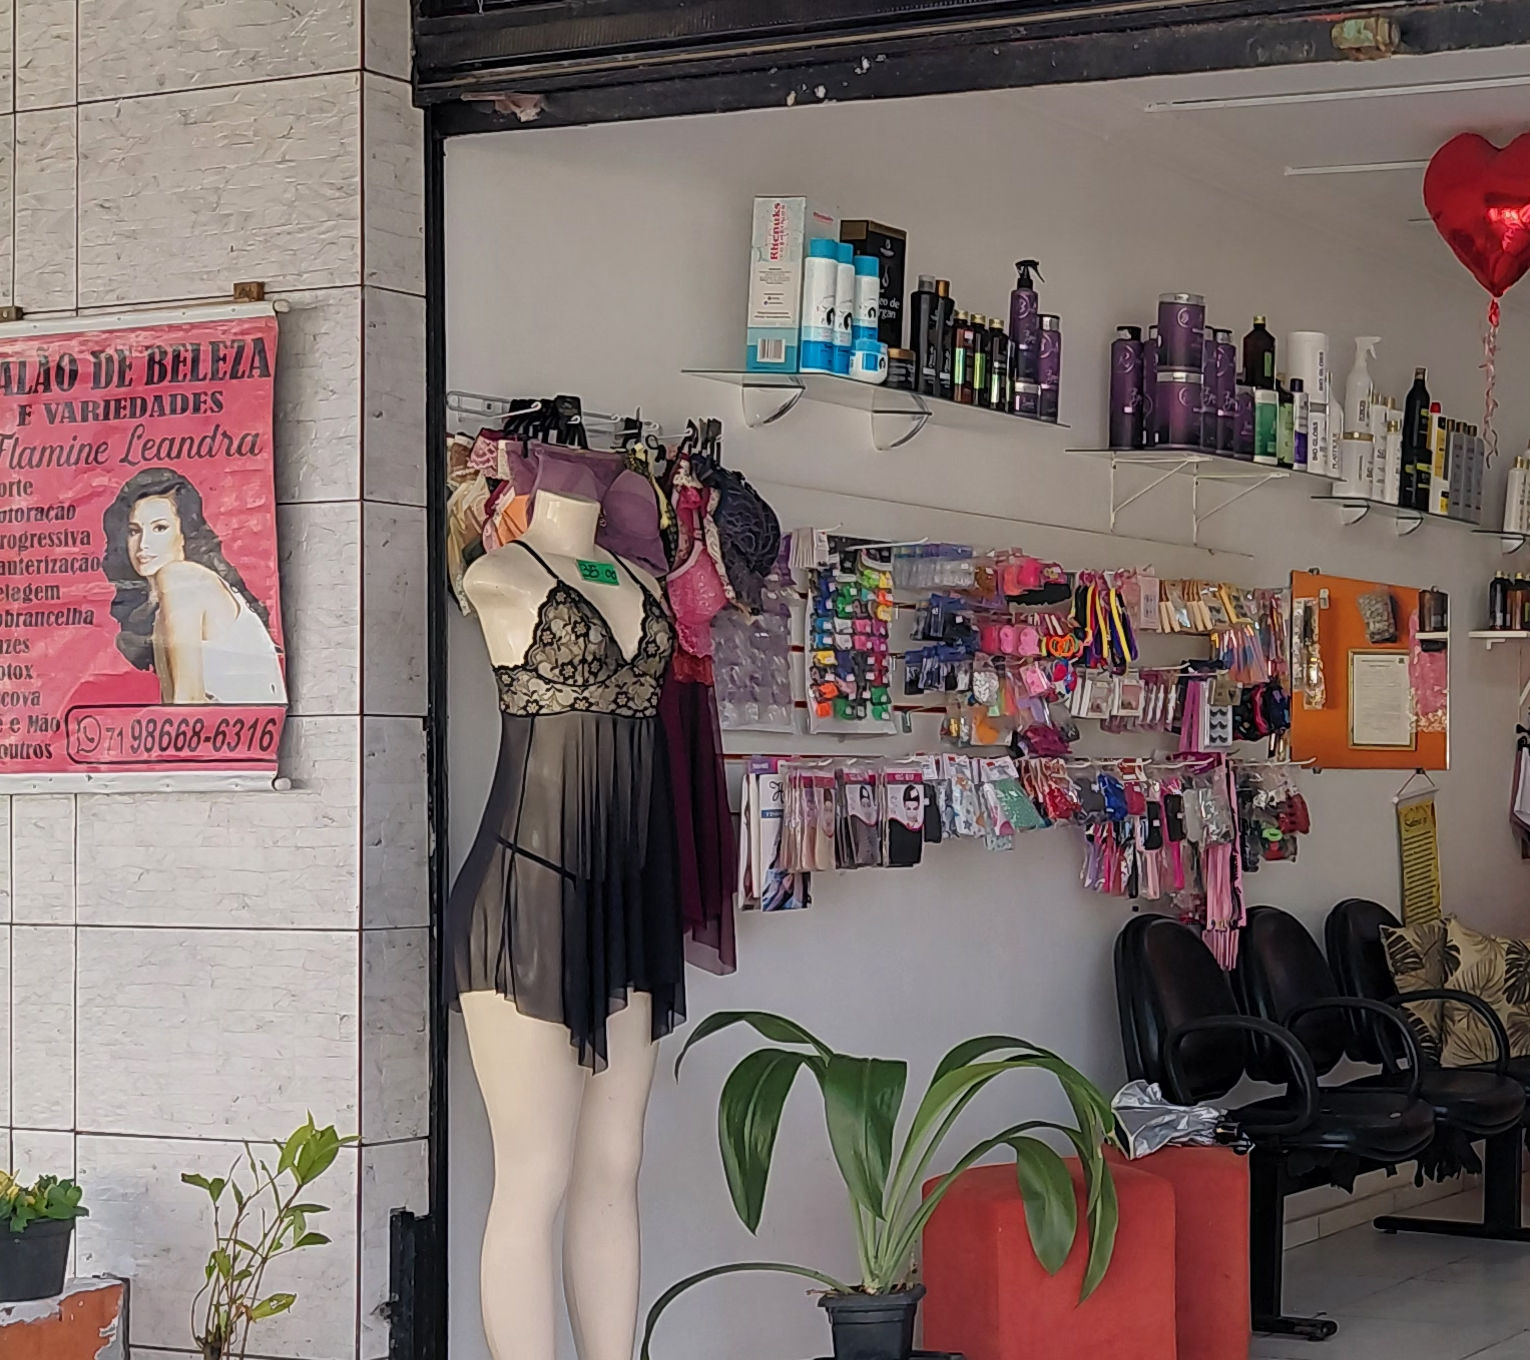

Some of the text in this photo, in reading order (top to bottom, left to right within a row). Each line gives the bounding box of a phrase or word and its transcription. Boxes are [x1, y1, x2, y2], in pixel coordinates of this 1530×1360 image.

[90, 348, 133, 392] DE
[144, 336, 272, 387] BELEZA
[17, 390, 225, 427] E VARIEDADES
[118, 423, 264, 467] Leandra
[0, 607, 95, 628] brancelha
[106, 717, 278, 754] 71 98668-6316
